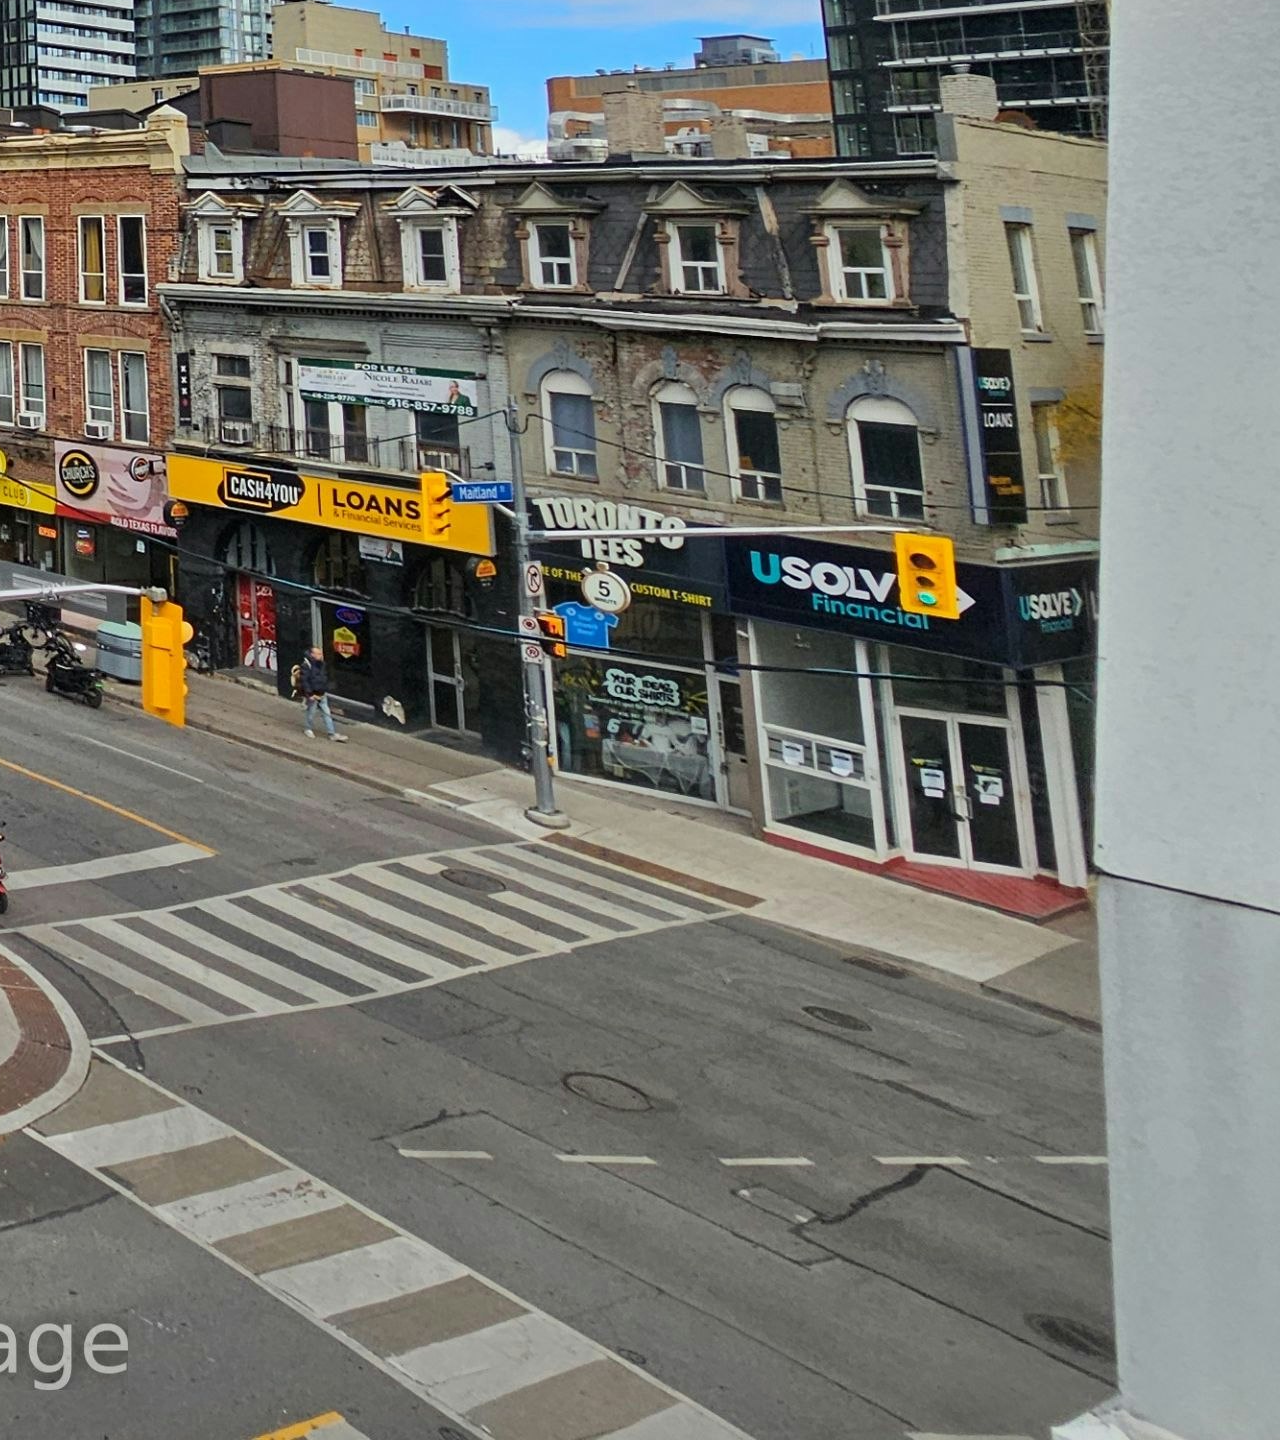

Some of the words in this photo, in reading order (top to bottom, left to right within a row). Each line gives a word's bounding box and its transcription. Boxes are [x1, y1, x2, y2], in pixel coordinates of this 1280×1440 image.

[354, 363, 378, 372] FOR
[380, 365, 416, 374] LEASE
[387, 398, 474, 416] 416-857-9788
[983, 412, 1013, 428] LOANS
[62, 465, 95, 481] CHURCH'S
[3, 486, 25, 500] CLUB
[230, 475, 300, 504] CASH4YOU
[332, 487, 421, 520] LOANS
[458, 485, 498, 500] Maitland
[128, 519, 151, 534] TEXAS
[333, 508, 339, 518] &
[342, 509, 382, 525] Financial
[383, 516, 422, 533] Services
[532, 497, 687, 550] TORONTO
[551, 567, 564, 578] OF
[564, 569, 583, 582] THE
[598, 580, 611, 597] 5
[629, 582, 671, 600] CUSTOM
[671, 590, 713, 607] T-SHIRT
[750, 550, 897, 603] USOLV
[811, 593, 929, 631] Financial
[1019, 591, 1073, 621] USOLVE
